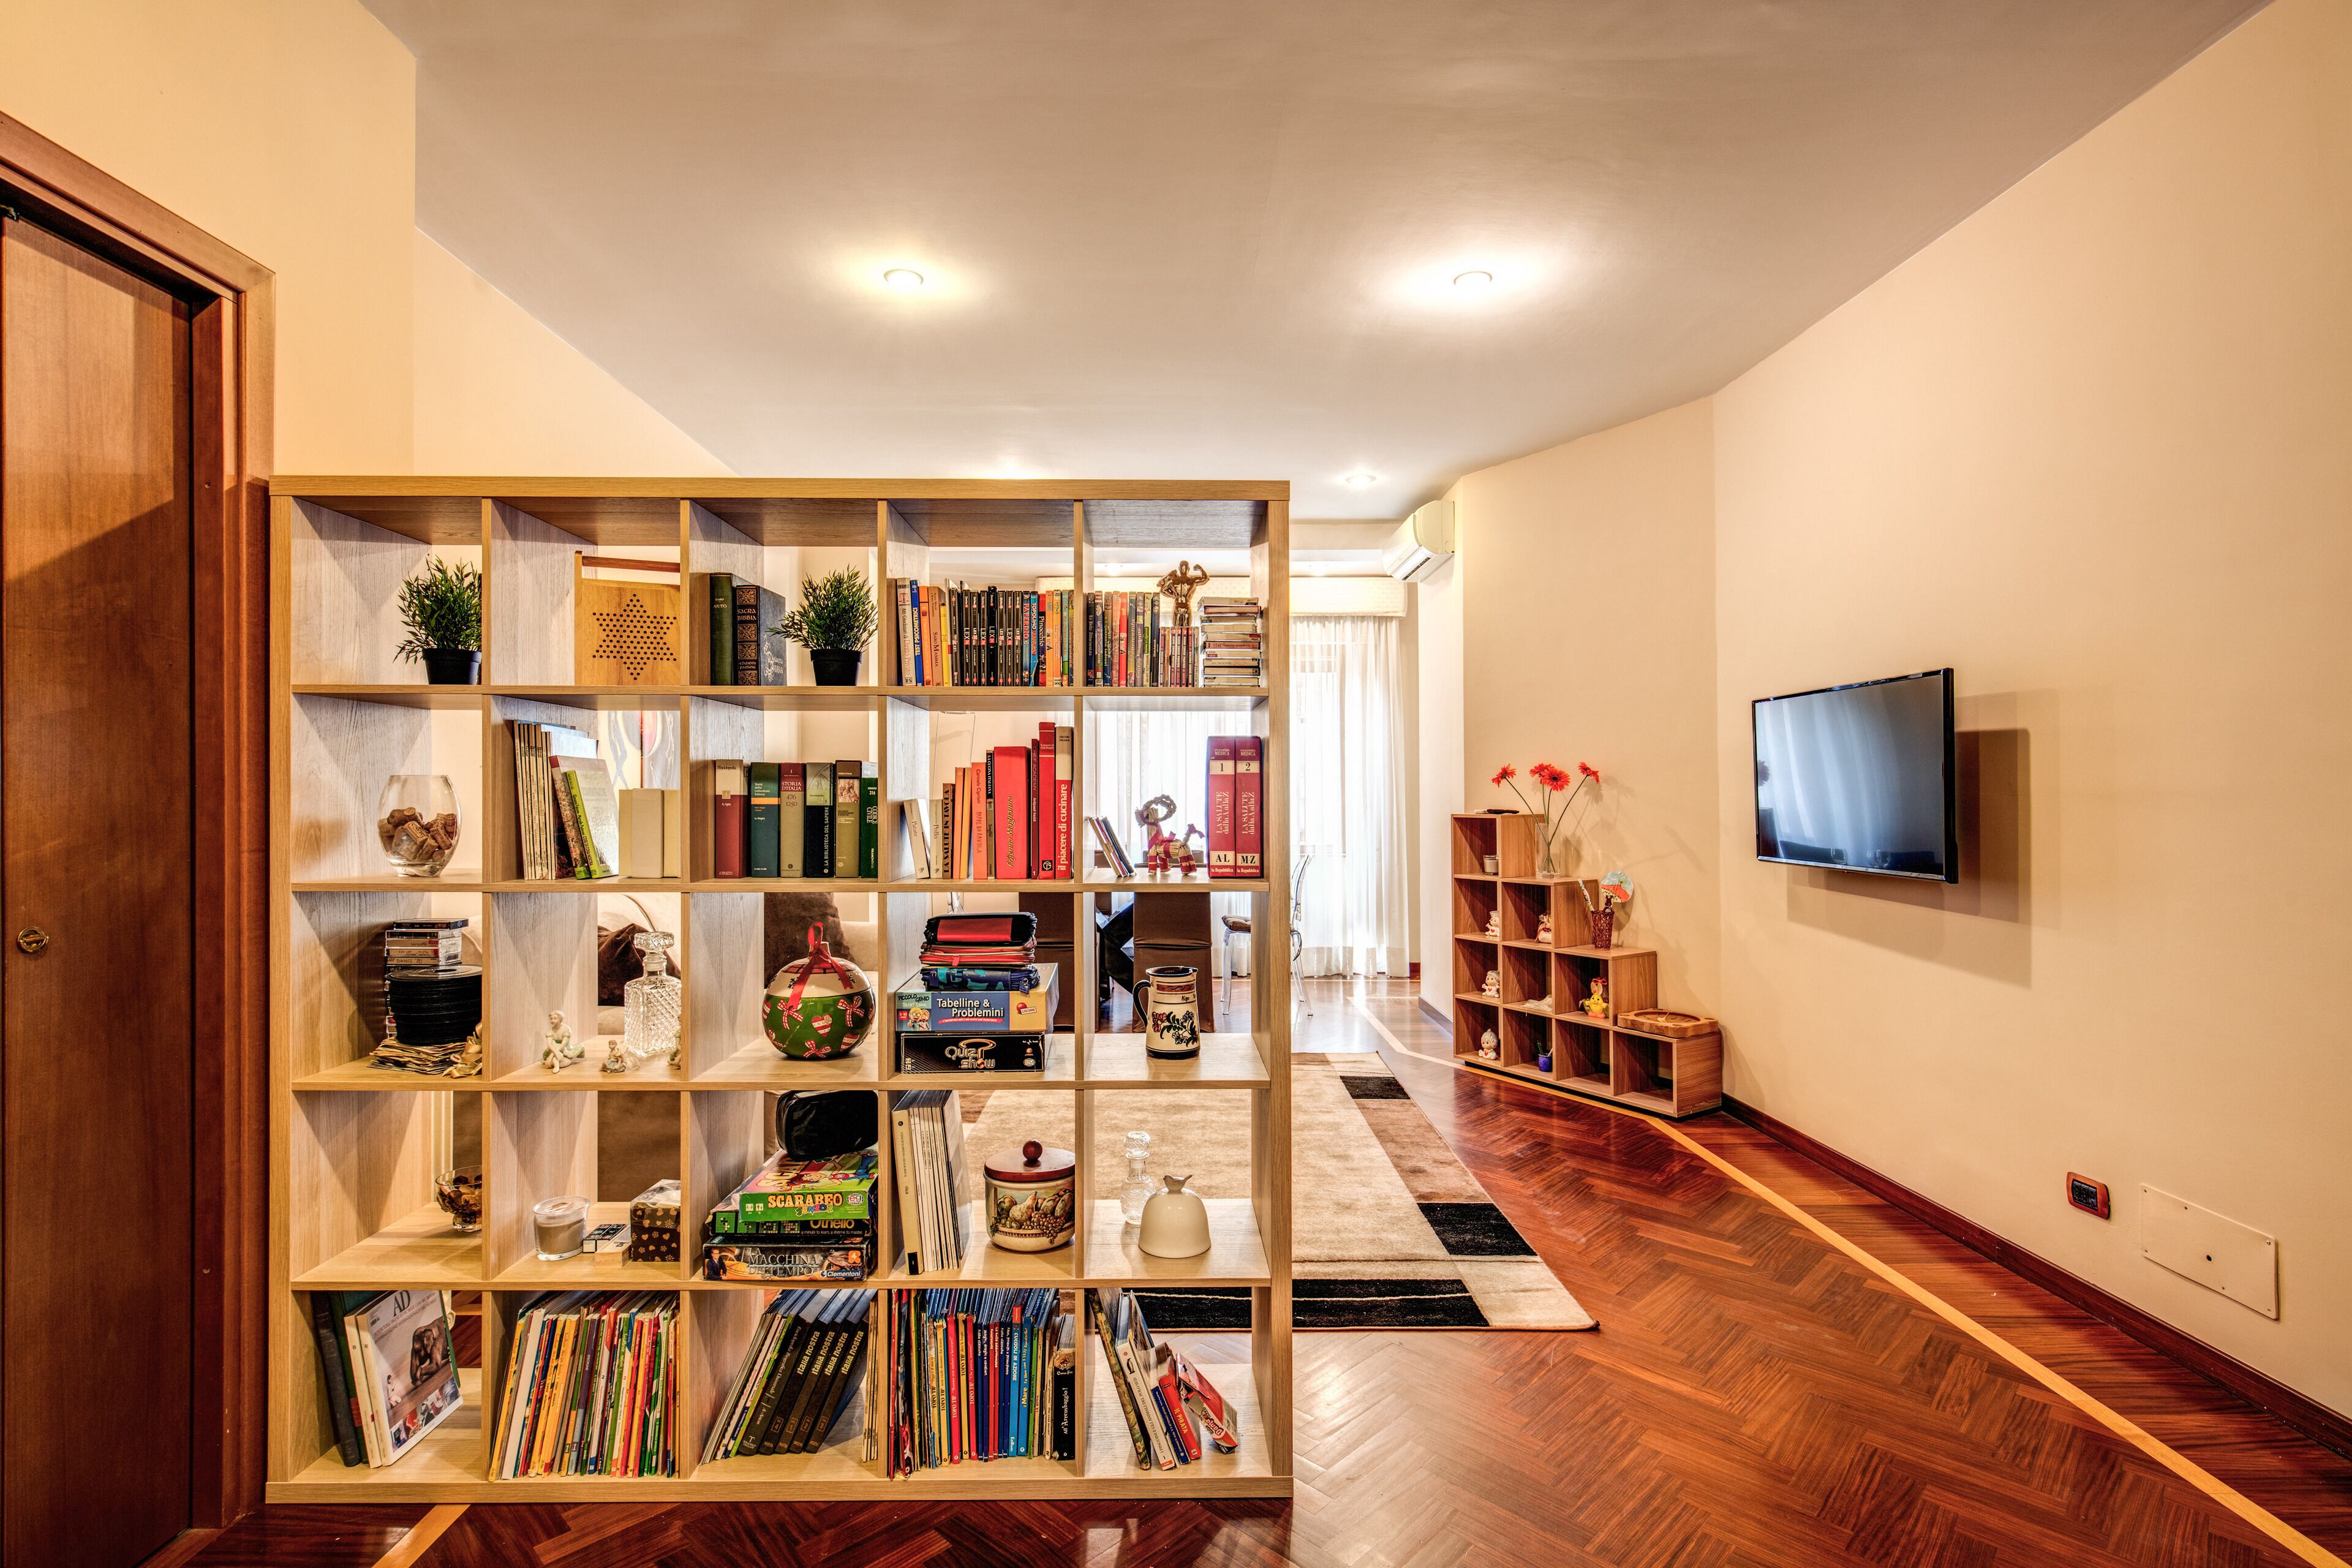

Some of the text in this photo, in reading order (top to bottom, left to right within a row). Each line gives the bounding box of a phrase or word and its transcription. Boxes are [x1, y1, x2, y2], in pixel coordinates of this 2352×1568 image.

[1245, 763, 1250, 771] 2
[1058, 784, 1068, 821] cucinare
[1058, 823, 1066, 831] di
[1216, 824, 1222, 833] LA
[1242, 824, 1248, 834] LA
[1057, 834, 1068, 864] piacere
[943, 862, 949, 872] LA
[937, 998, 979, 1008] Tabelline
[952, 1008, 1003, 1017] Problemini
[768, 1193, 843, 1208] SCARABEO
[795, 1205, 834, 1216] JUNIOR
[748, 1254, 816, 1264] MACCHINA
[769, 1267, 814, 1276] TEMPO
[394, 1290, 410, 1317] AD
[807, 1331, 820, 1355] nostra
[821, 1331, 835, 1355] nostra
[835, 1332, 848, 1356] nostra
[851, 1331, 864, 1355] nostra
[1143, 1404, 1152, 1422] ANIMALI
[1177, 1412, 1188, 1434] PIRATA
[1208, 1420, 1224, 1437] Dama
[1155, 1432, 1163, 1450] PINGUINI
